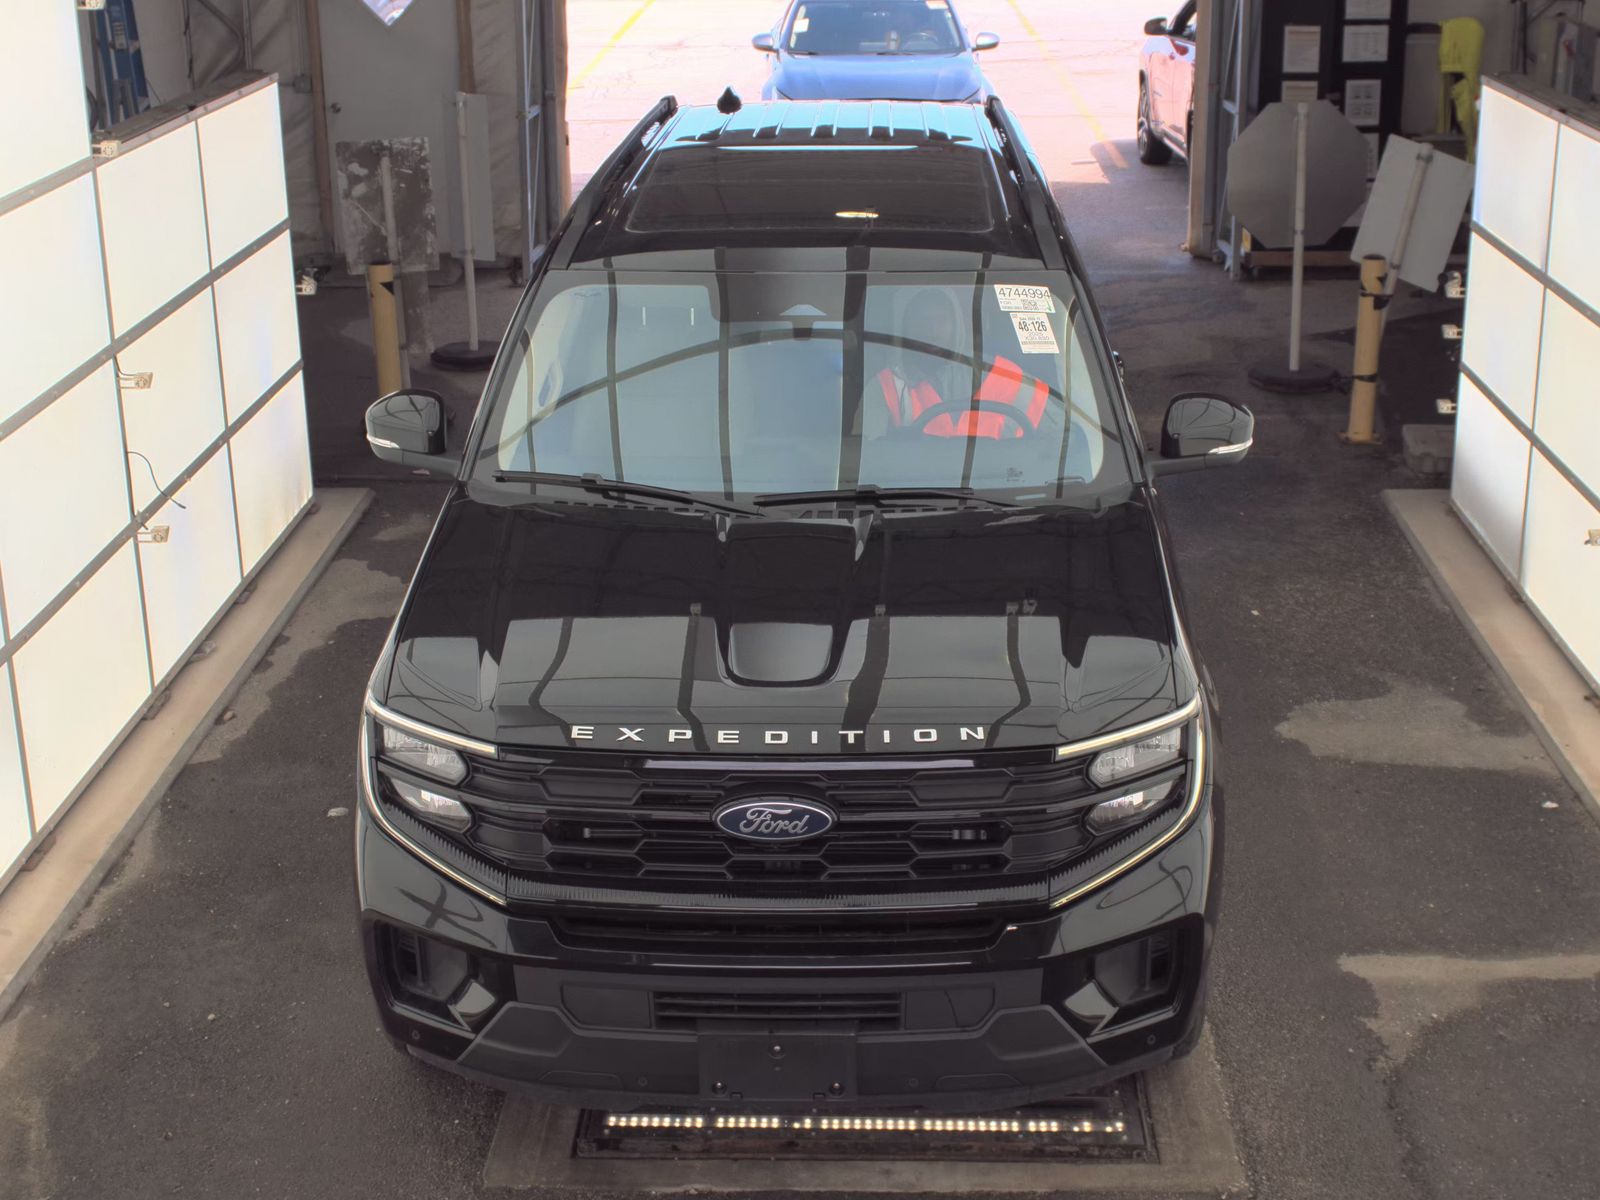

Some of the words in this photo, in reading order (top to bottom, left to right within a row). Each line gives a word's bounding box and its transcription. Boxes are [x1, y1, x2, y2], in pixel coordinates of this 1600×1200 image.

[998, 287, 1051, 299] 4744994
[1018, 320, 1047, 332] 48:126
[570, 724, 985, 745] EXPEDITION
[739, 806, 810, 835] Ford
